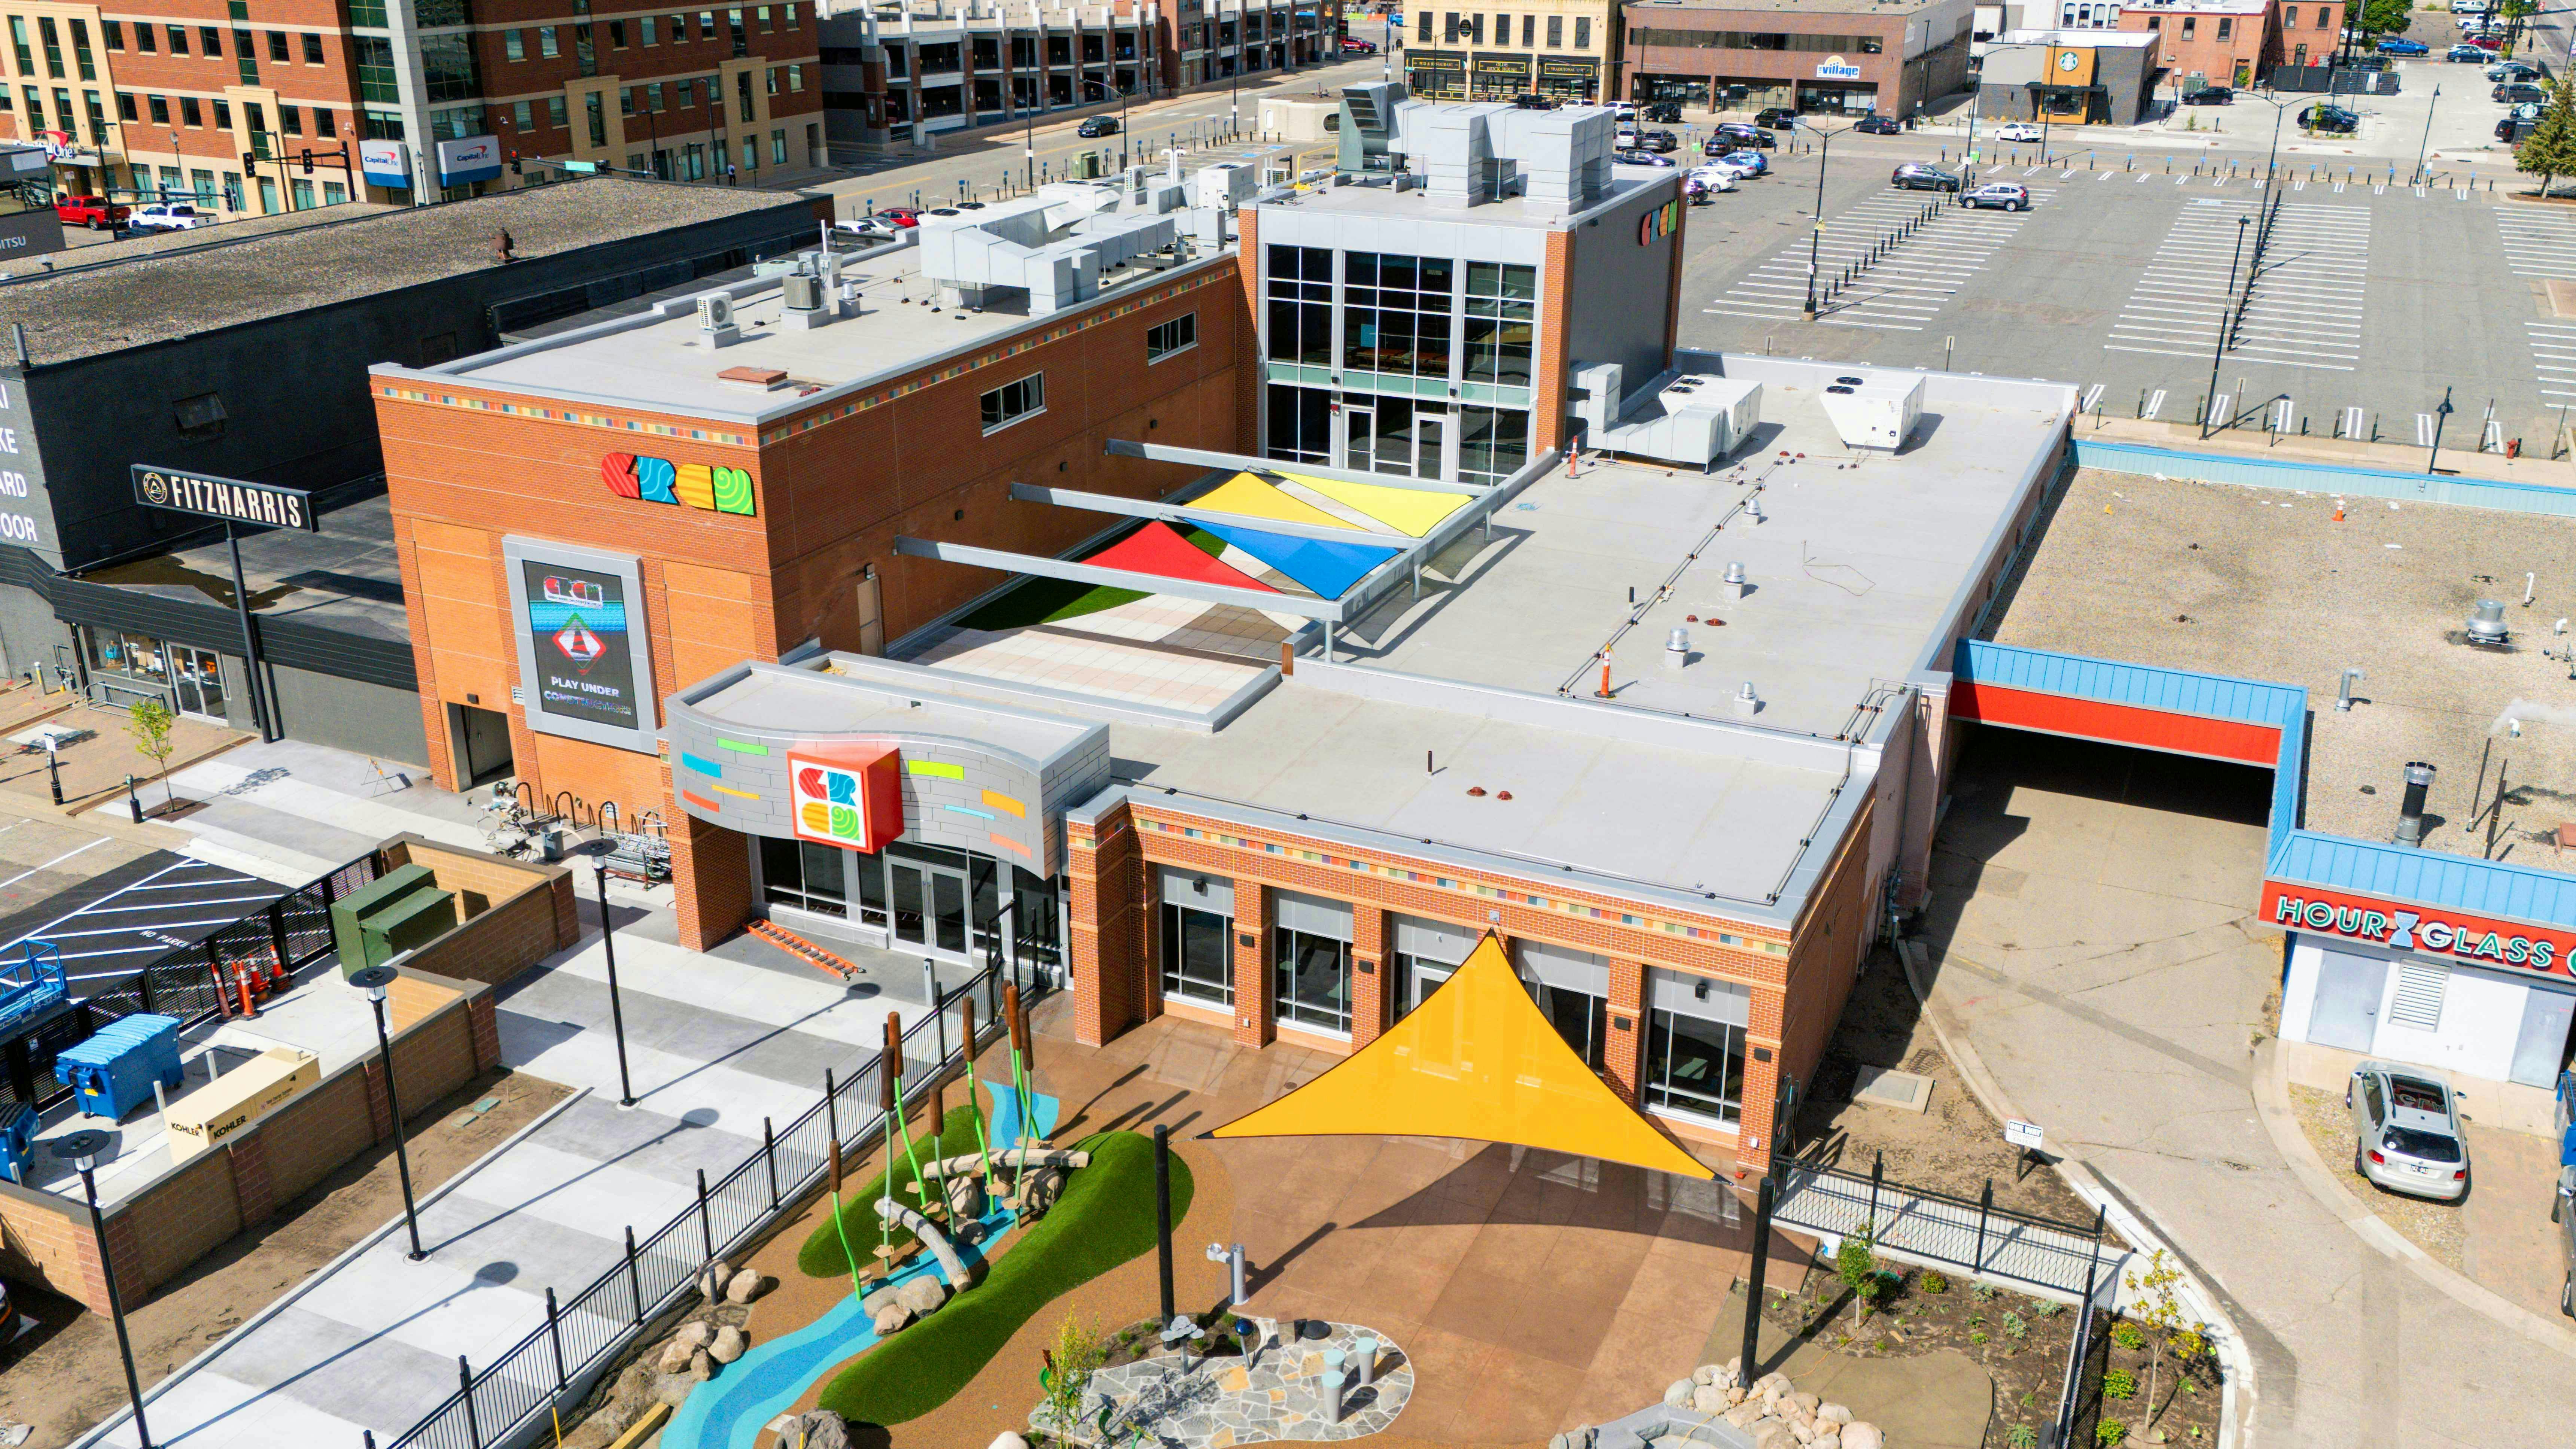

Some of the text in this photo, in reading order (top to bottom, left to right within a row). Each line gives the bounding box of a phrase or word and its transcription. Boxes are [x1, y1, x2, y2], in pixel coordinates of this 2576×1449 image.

[1823, 62, 1858, 77] village
[0, 235, 26, 249] ITSU
[170, 476, 301, 527] FITZHARRIS
[0, 512, 38, 542] OOR
[551, 676, 619, 697] PLAY UNDER
[2276, 895, 2387, 938] HOUR
[2421, 920, 2555, 968] GLASS
[31, 992, 63, 1012] GS-3232
[171, 1122, 200, 1137] KOHLER
[214, 1115, 246, 1139] KOHLER
[2009, 1122, 2041, 1137] ONE WAY
[2013, 1137, 2034, 1145] ENTER
